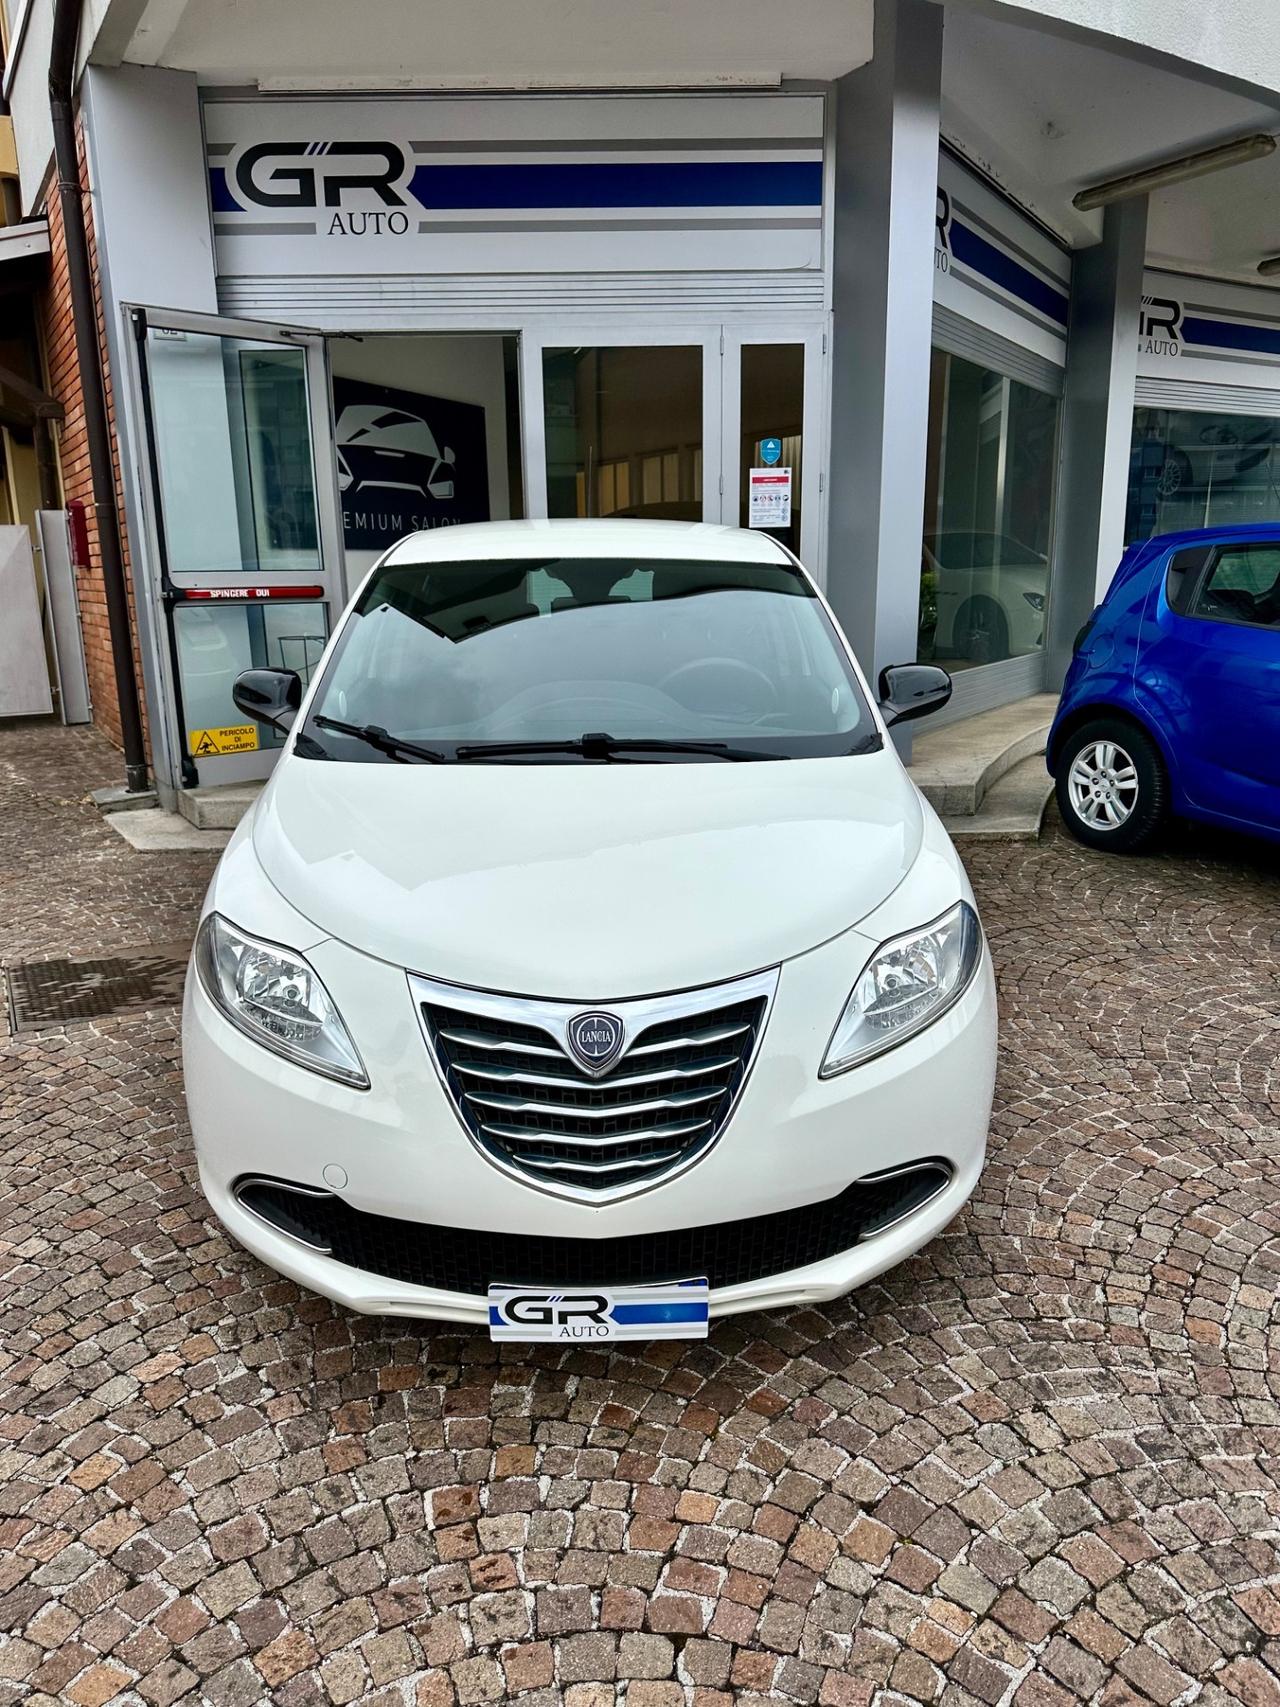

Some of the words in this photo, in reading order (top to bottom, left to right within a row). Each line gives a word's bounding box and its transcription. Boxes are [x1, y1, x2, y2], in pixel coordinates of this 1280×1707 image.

[236, 141, 408, 208] GR
[327, 211, 409, 236] AUTO
[1145, 339, 1179, 357] AUTO
[219, 727, 255, 737] PERICOLO
[221, 741, 255, 751] INCIAMPO
[581, 1030, 612, 1043] LANCIA
[504, 1295, 609, 1325] GR
[559, 1325, 610, 1338] AUTO
